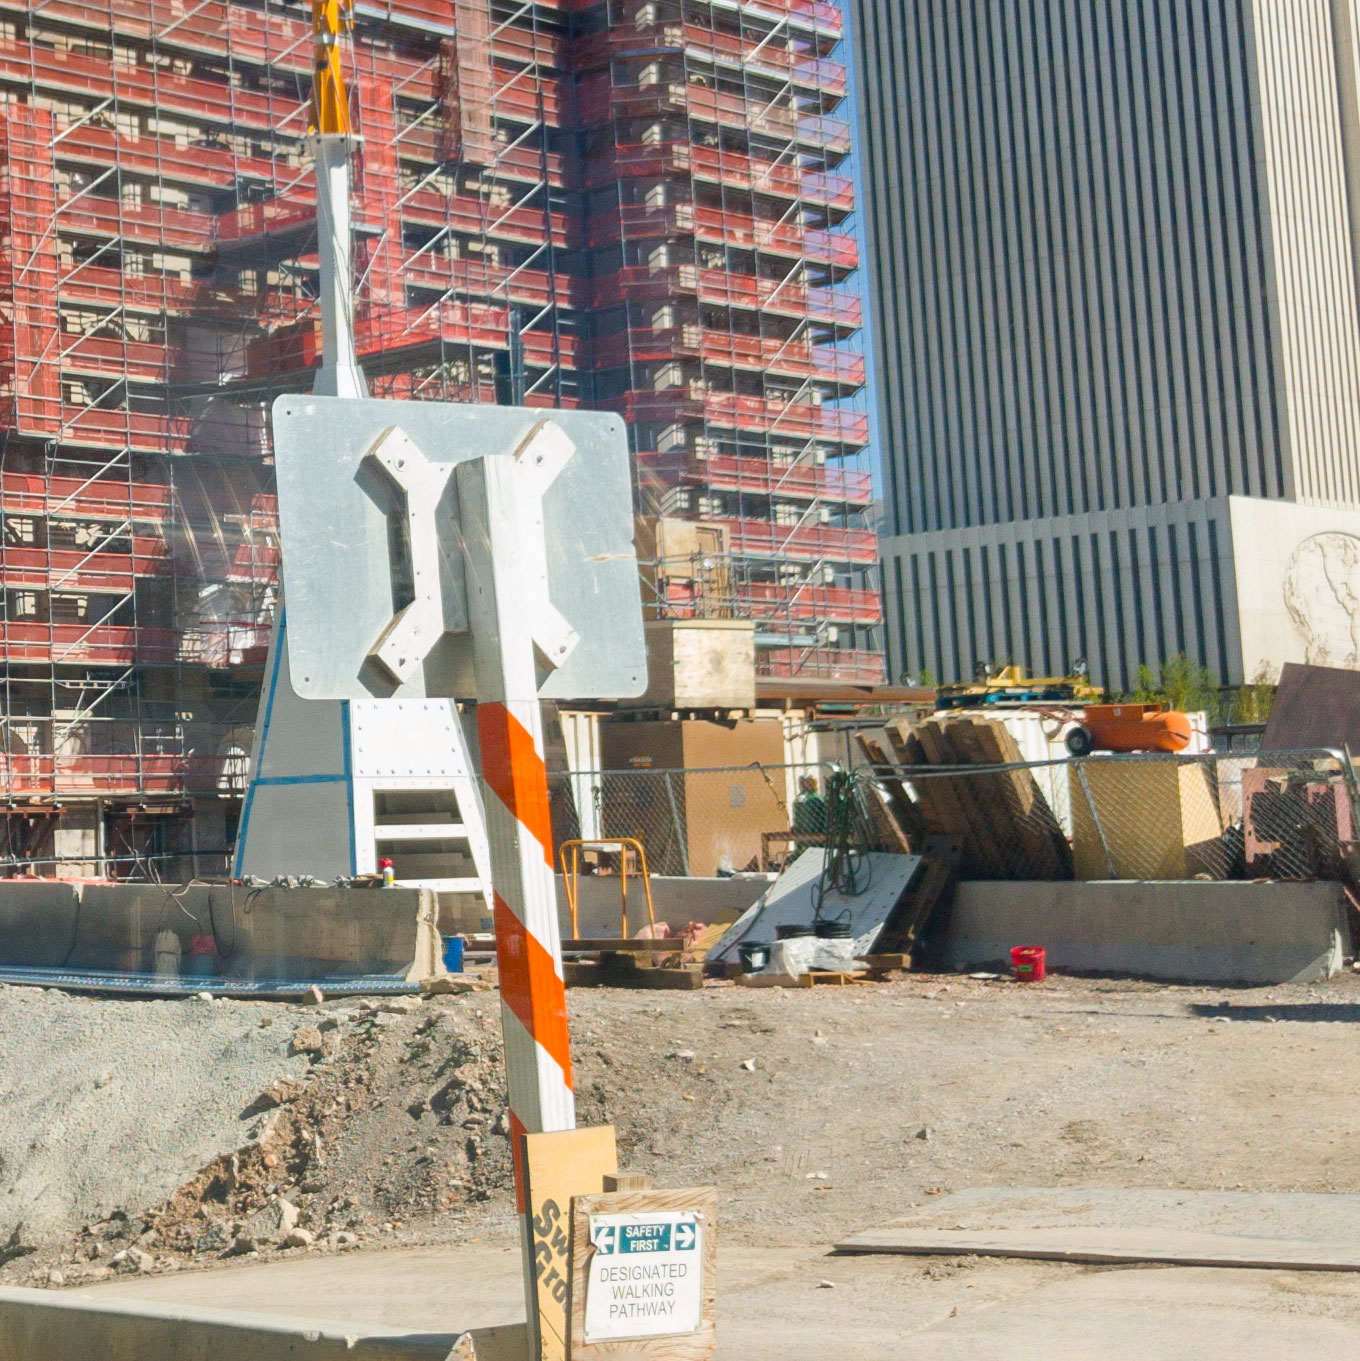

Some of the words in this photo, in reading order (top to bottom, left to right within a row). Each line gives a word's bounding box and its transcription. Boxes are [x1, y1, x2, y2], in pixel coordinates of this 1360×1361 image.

[625, 1225, 666, 1238] SAFETY
[630, 1239, 659, 1252] FIRST
[600, 1263, 687, 1282] DESIGNATED
[611, 1282, 675, 1300] WALKING
[609, 1300, 676, 1319] PATHWAY
